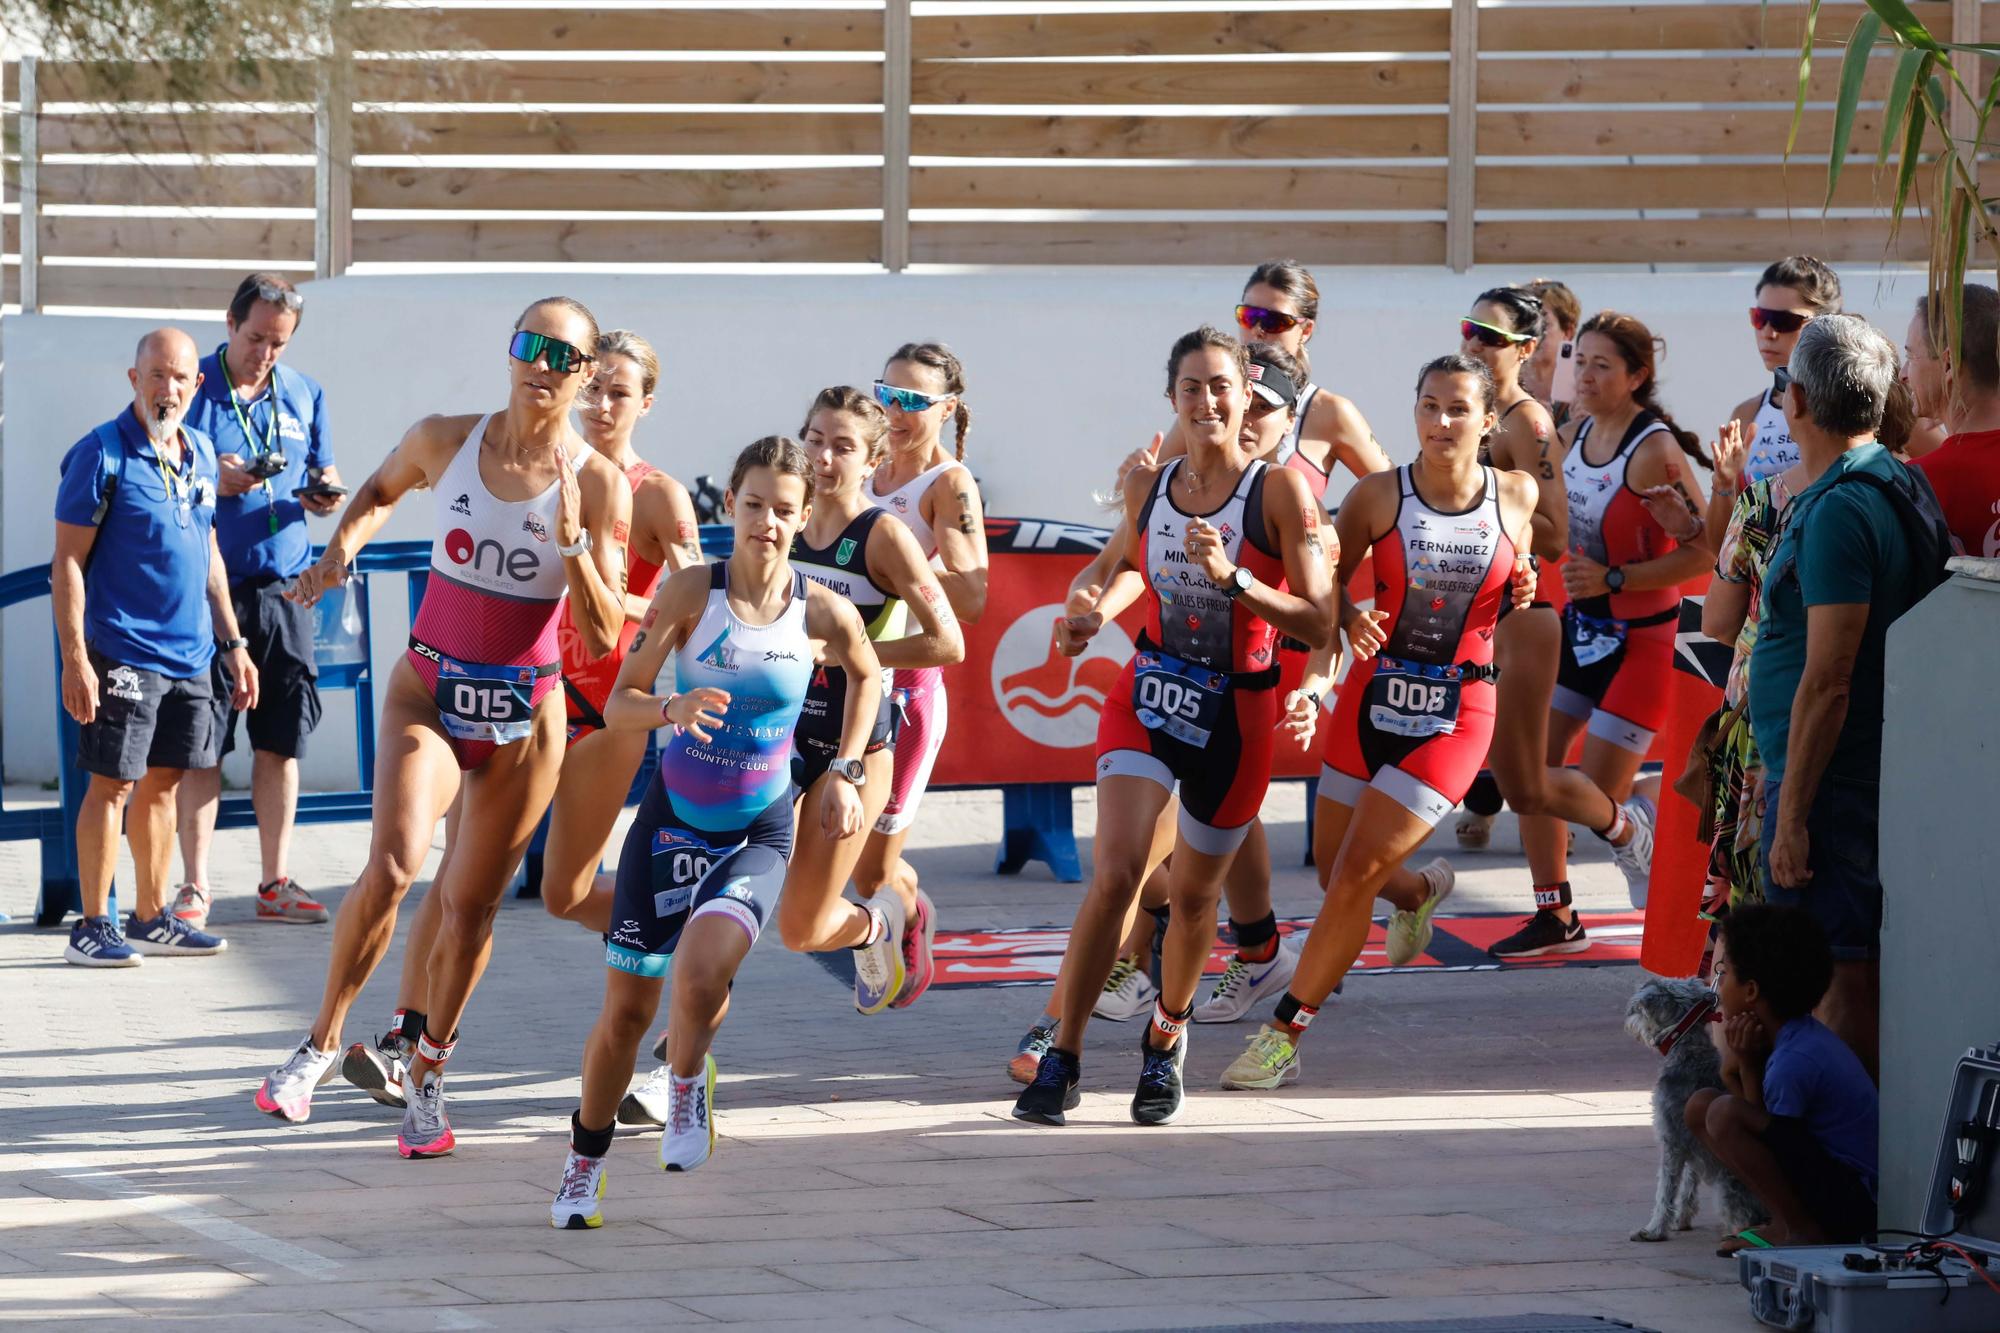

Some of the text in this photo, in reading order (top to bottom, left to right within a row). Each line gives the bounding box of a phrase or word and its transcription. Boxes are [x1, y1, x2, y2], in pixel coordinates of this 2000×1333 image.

[1410, 539, 1489, 555] FERNÁNDEZ
[1438, 559, 1486, 575] Puchet
[803, 573, 852, 598] ABLANCA
[705, 658, 741, 671] ACADEMY
[763, 650, 799, 662] Spiuk
[454, 684, 513, 719] 015
[1140, 676, 1203, 719] 005
[1387, 677, 1447, 713] 008
[685, 746, 769, 772] COUNTRY CLUB
[612, 930, 648, 950] Spiuk
[696, 1085, 707, 1131] HOKA
